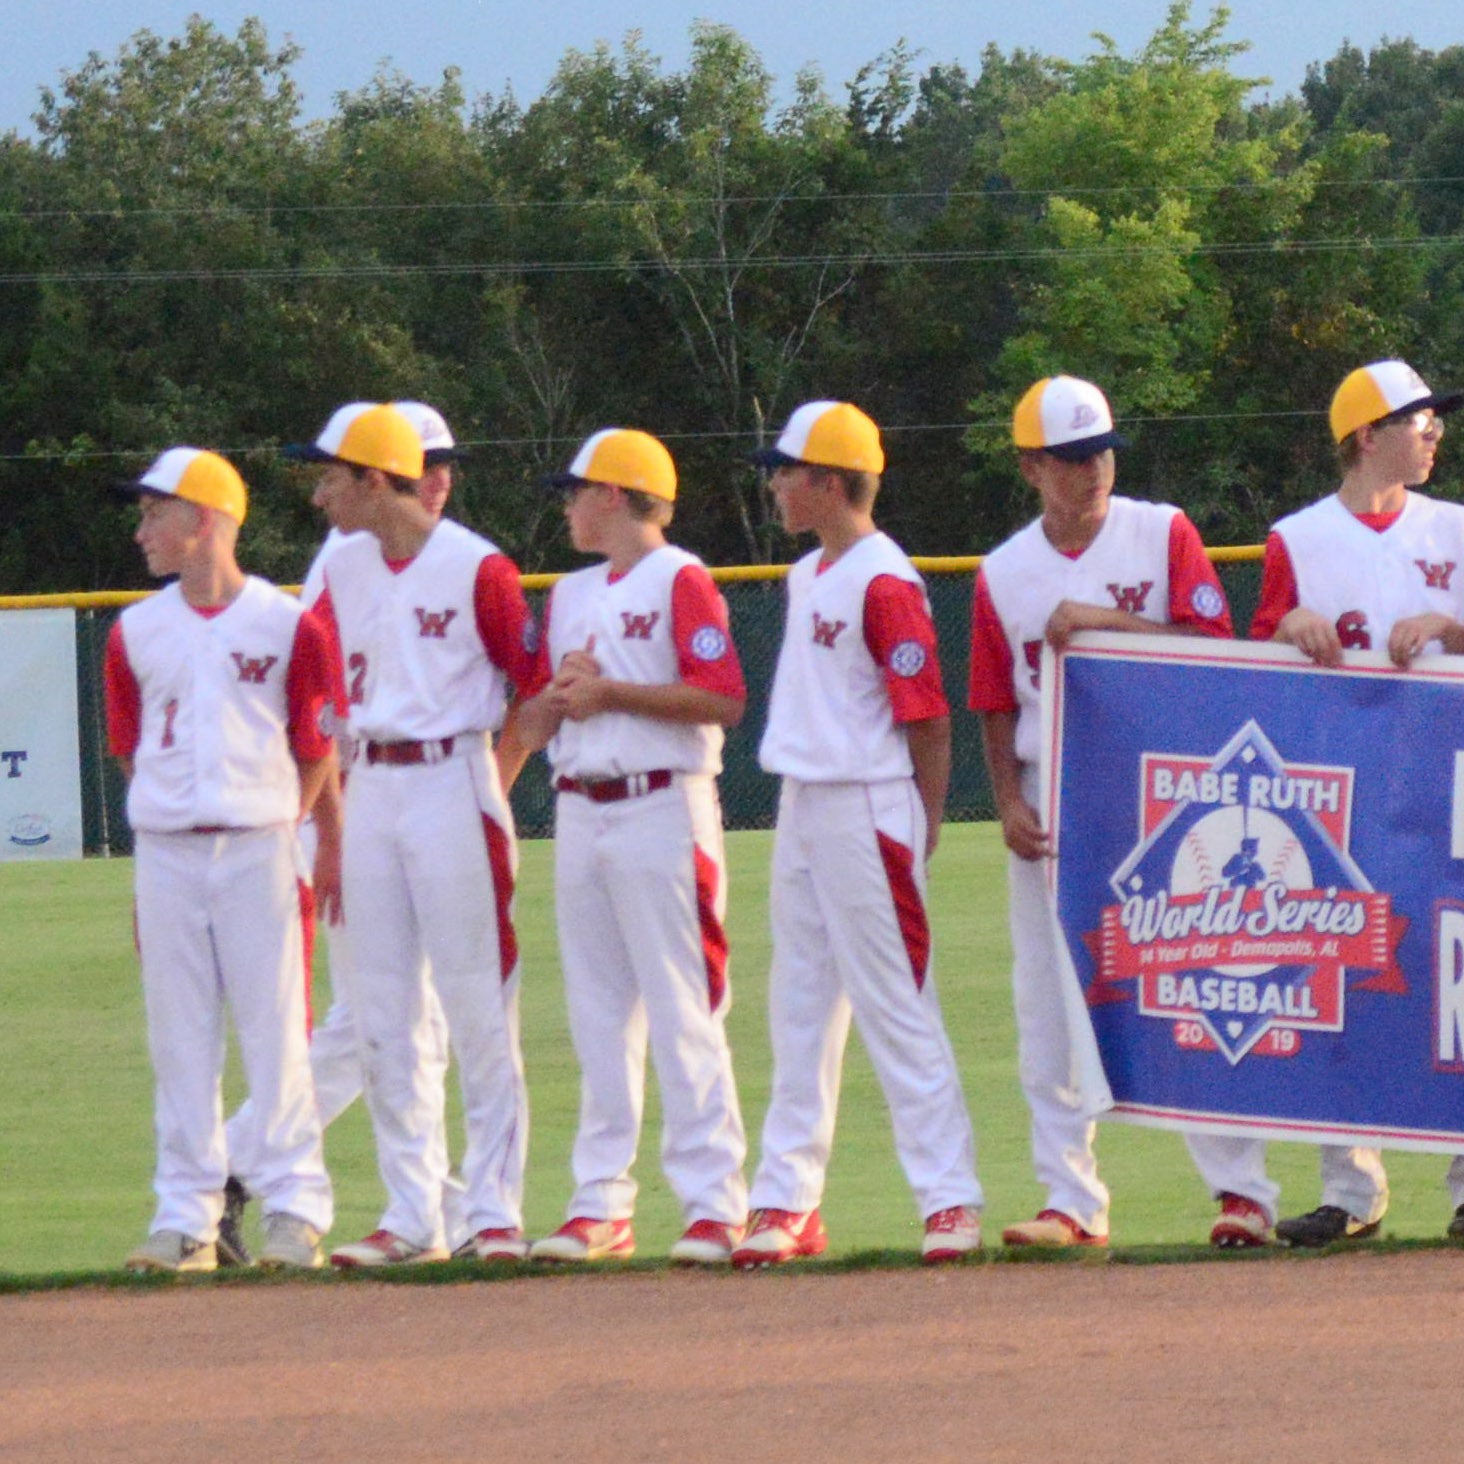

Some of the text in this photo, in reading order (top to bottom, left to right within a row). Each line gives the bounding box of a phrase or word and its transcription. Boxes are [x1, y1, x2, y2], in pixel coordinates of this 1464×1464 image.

[1415, 559, 1458, 591] W
[1106, 580, 1154, 614] W
[414, 607, 458, 639] W
[621, 610, 660, 641] W
[812, 612, 847, 650] W
[230, 652, 279, 684] W
[348, 652, 368, 704] 2
[161, 699, 180, 749] 1
[1153, 768, 1340, 814] BABE RUTH
[1121, 882, 1366, 945] World Series
[1158, 946, 1189, 962] Year
[1191, 942, 1219, 960] Old
[1157, 973, 1318, 1018] BASEBALL
[1175, 1022, 1295, 1052] 20 19
